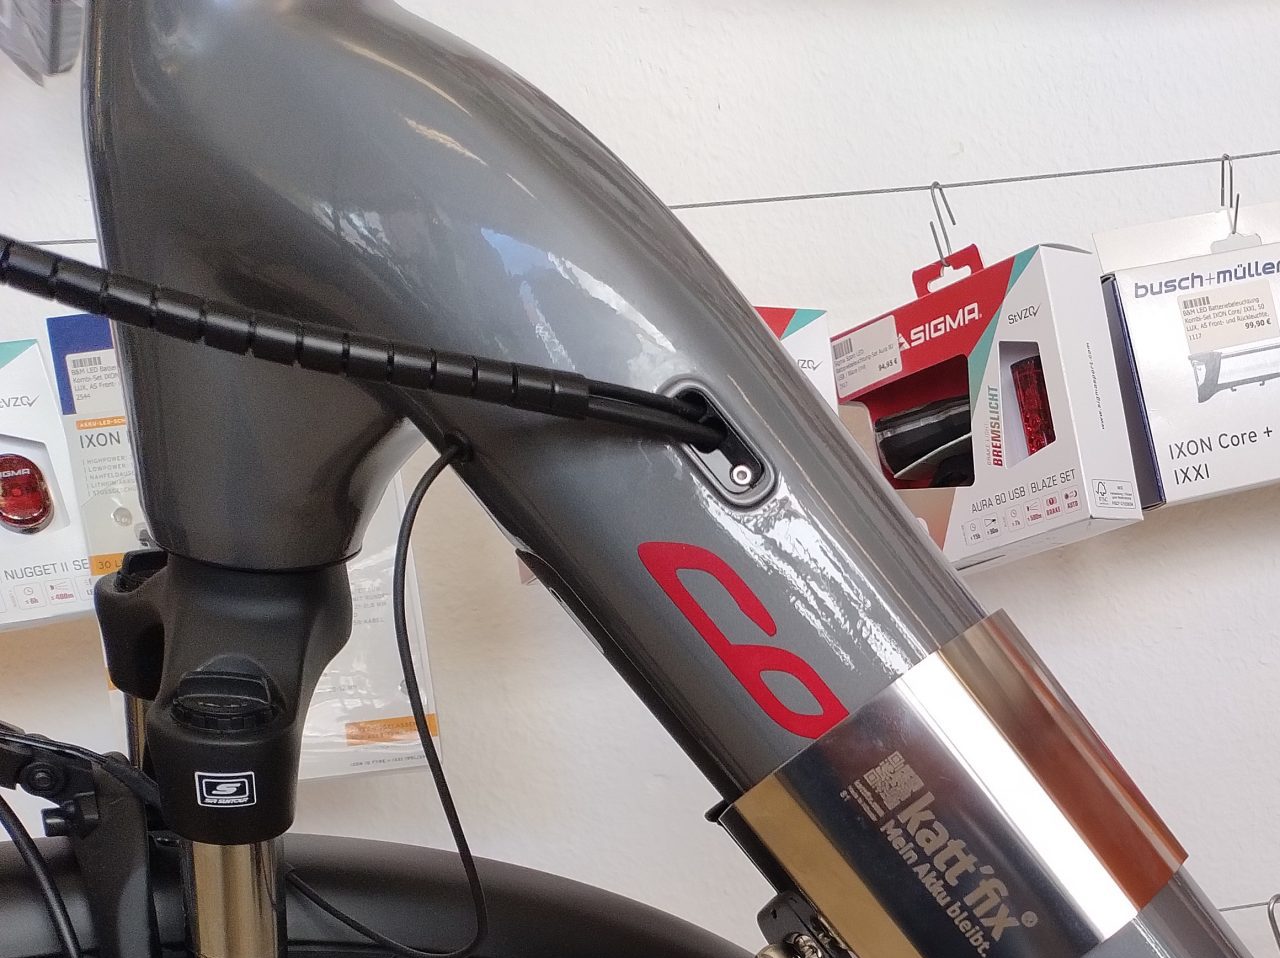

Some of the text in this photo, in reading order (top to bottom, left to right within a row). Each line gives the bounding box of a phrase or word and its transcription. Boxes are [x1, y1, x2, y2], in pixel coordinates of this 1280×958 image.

[910, 302, 982, 347] SIGMA
[1245, 319, 1265, 330] 99,90
[987, 385, 1003, 467] BREMSLICHT
[79, 431, 121, 450] IXON
[1168, 436, 1212, 461] IXON
[1219, 428, 1258, 449] Core
[1173, 462, 1211, 485] IXXI
[971, 468, 1076, 514] AURA 80 USB BLAZE SET
[4, 563, 57, 581] NUGGET
[98, 559, 111, 569] 30
[880, 819, 918, 865] Mein
[912, 862, 950, 907] Akku
